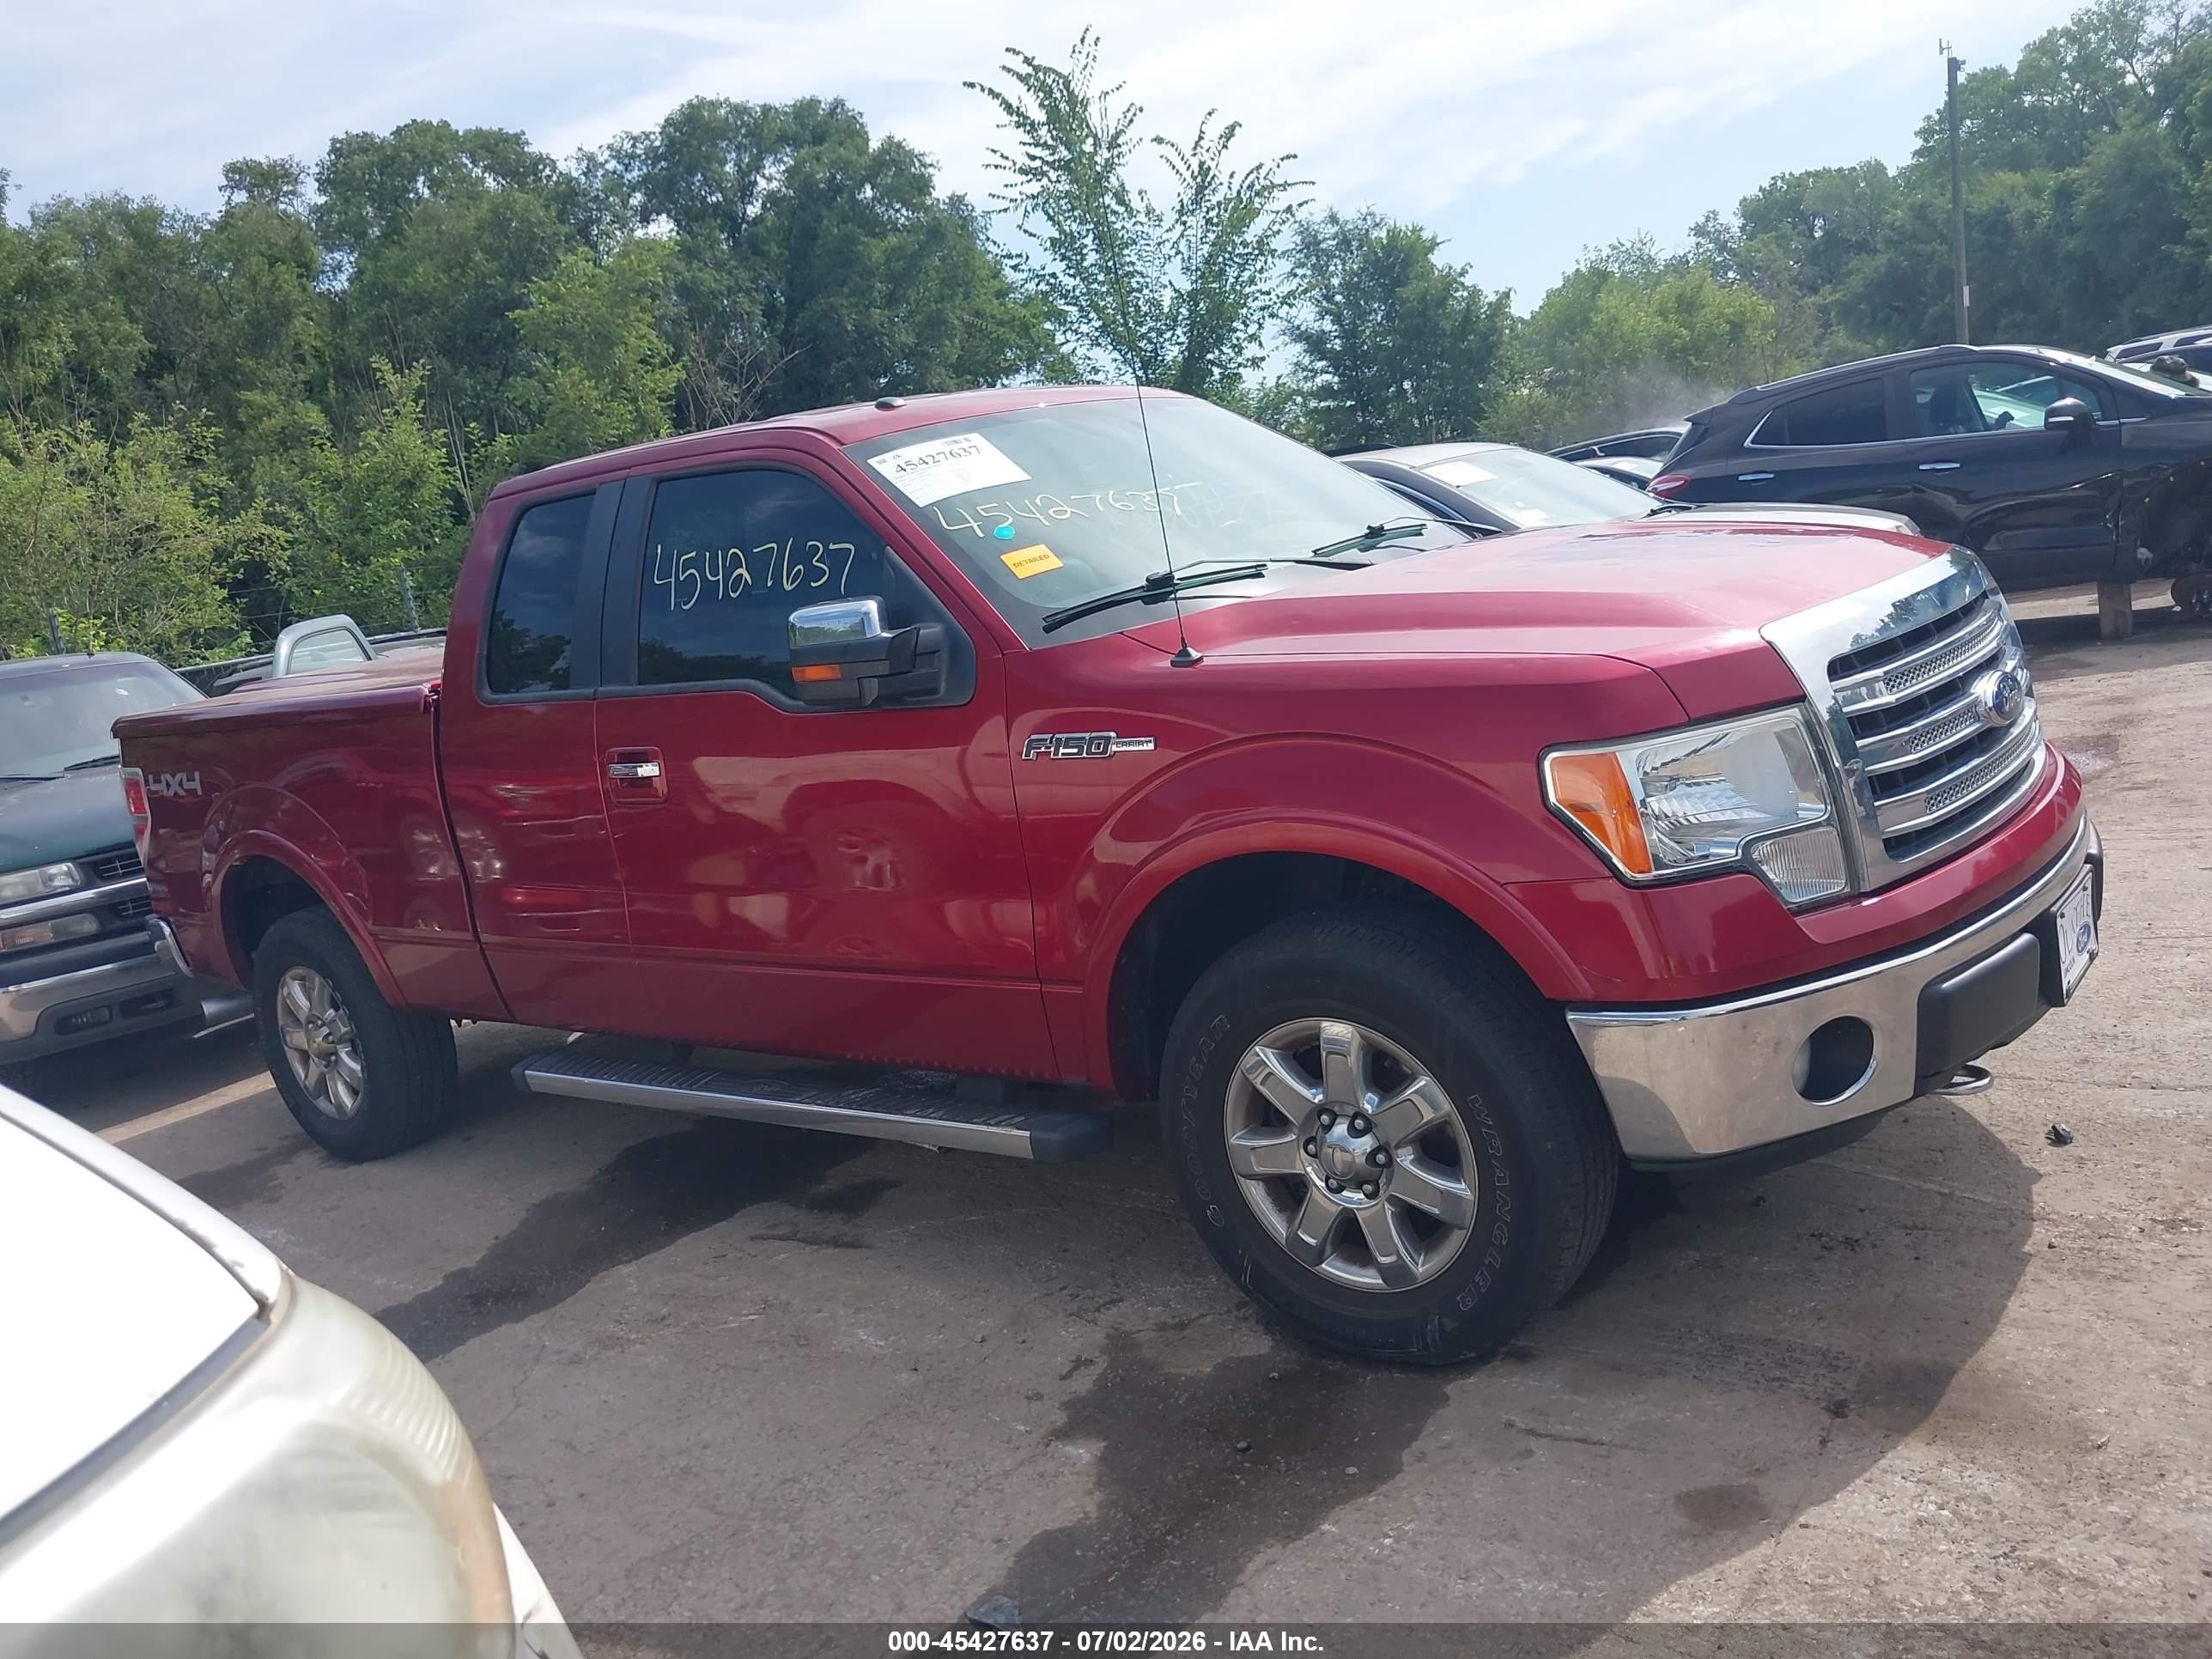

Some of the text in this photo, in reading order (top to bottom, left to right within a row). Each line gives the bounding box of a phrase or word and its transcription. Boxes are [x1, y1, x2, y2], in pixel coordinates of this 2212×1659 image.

[895, 445, 982, 474] 45427637
[653, 536, 856, 611] 45427637
[1012, 554, 1050, 568] DETAILED
[1022, 732, 1118, 761] F-150
[1180, 1014, 1231, 1228] GOODYEAR
[1457, 1093, 1514, 1313] WRANGLER
